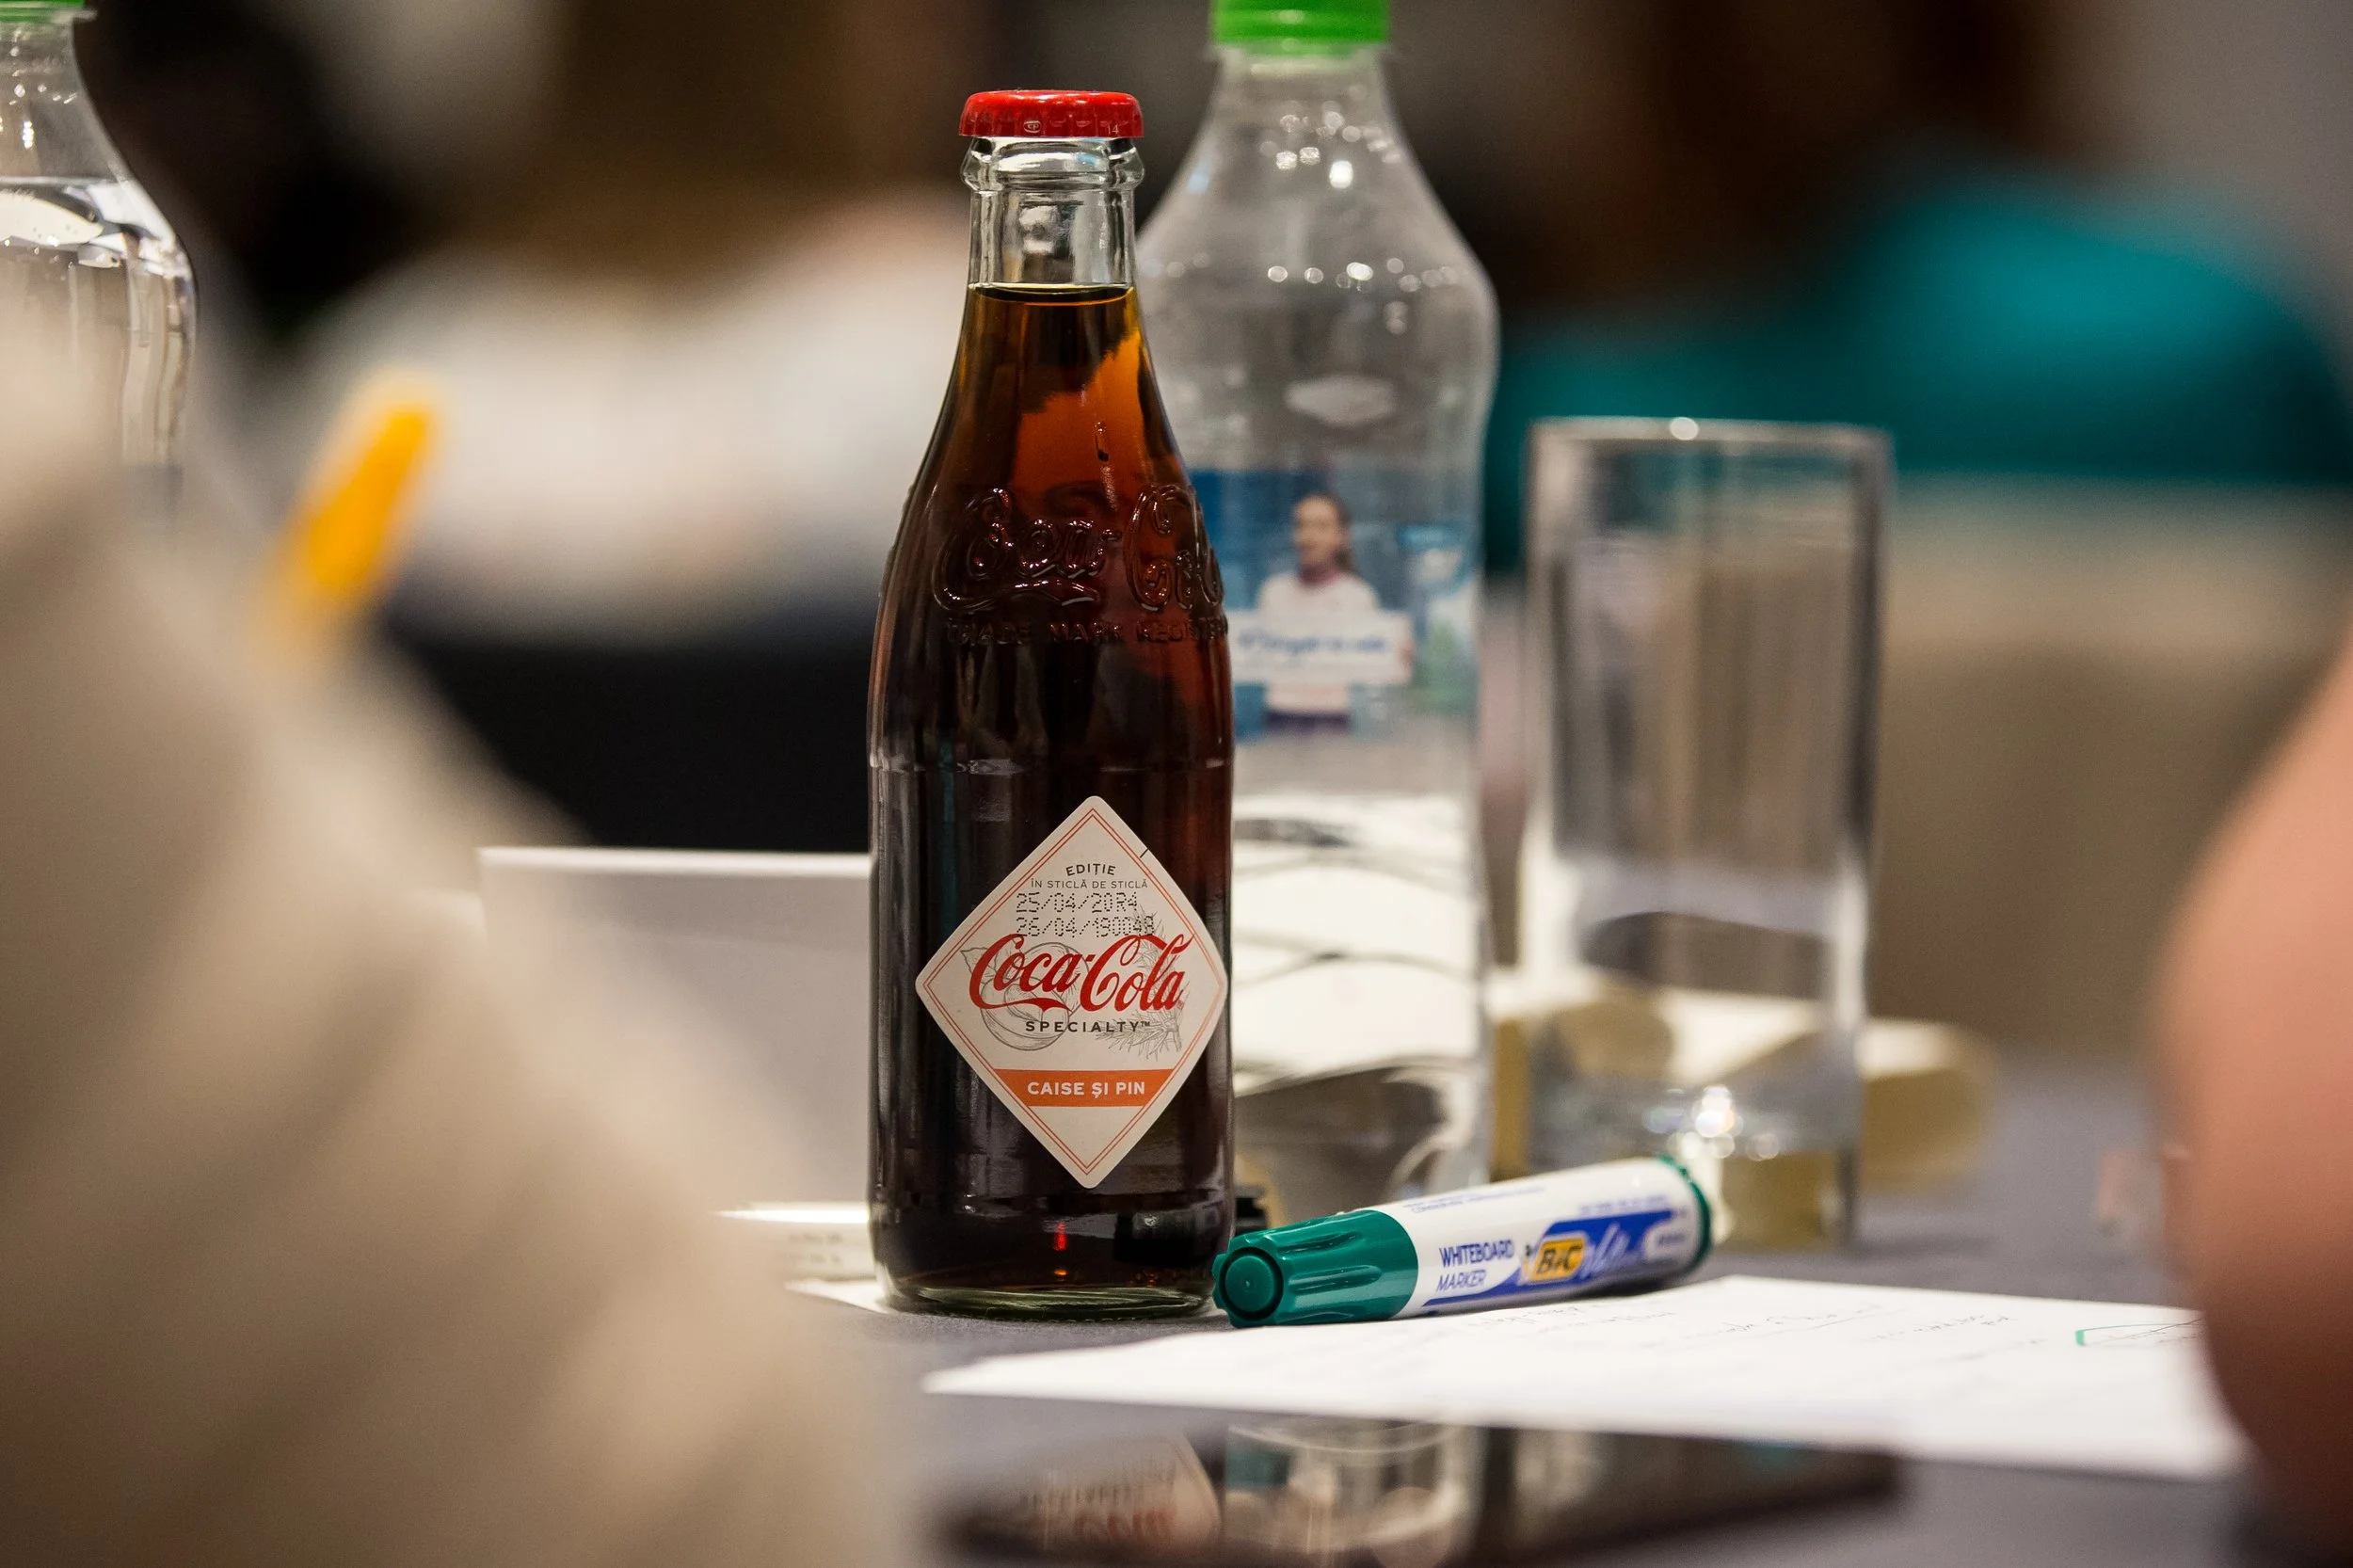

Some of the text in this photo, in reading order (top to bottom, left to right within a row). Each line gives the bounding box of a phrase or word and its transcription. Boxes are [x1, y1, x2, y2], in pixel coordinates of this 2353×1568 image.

[1031, 878, 1148, 888] ÎN STICLĂ DE STICLĂ
[968, 933, 1194, 1013] Coca-Cola
[1027, 1081, 1084, 1096] CAISE
[1115, 1081, 1145, 1095] PIN
[1438, 1239, 1515, 1268] WHITEBOARD
[1435, 1269, 1487, 1294] MARKER
